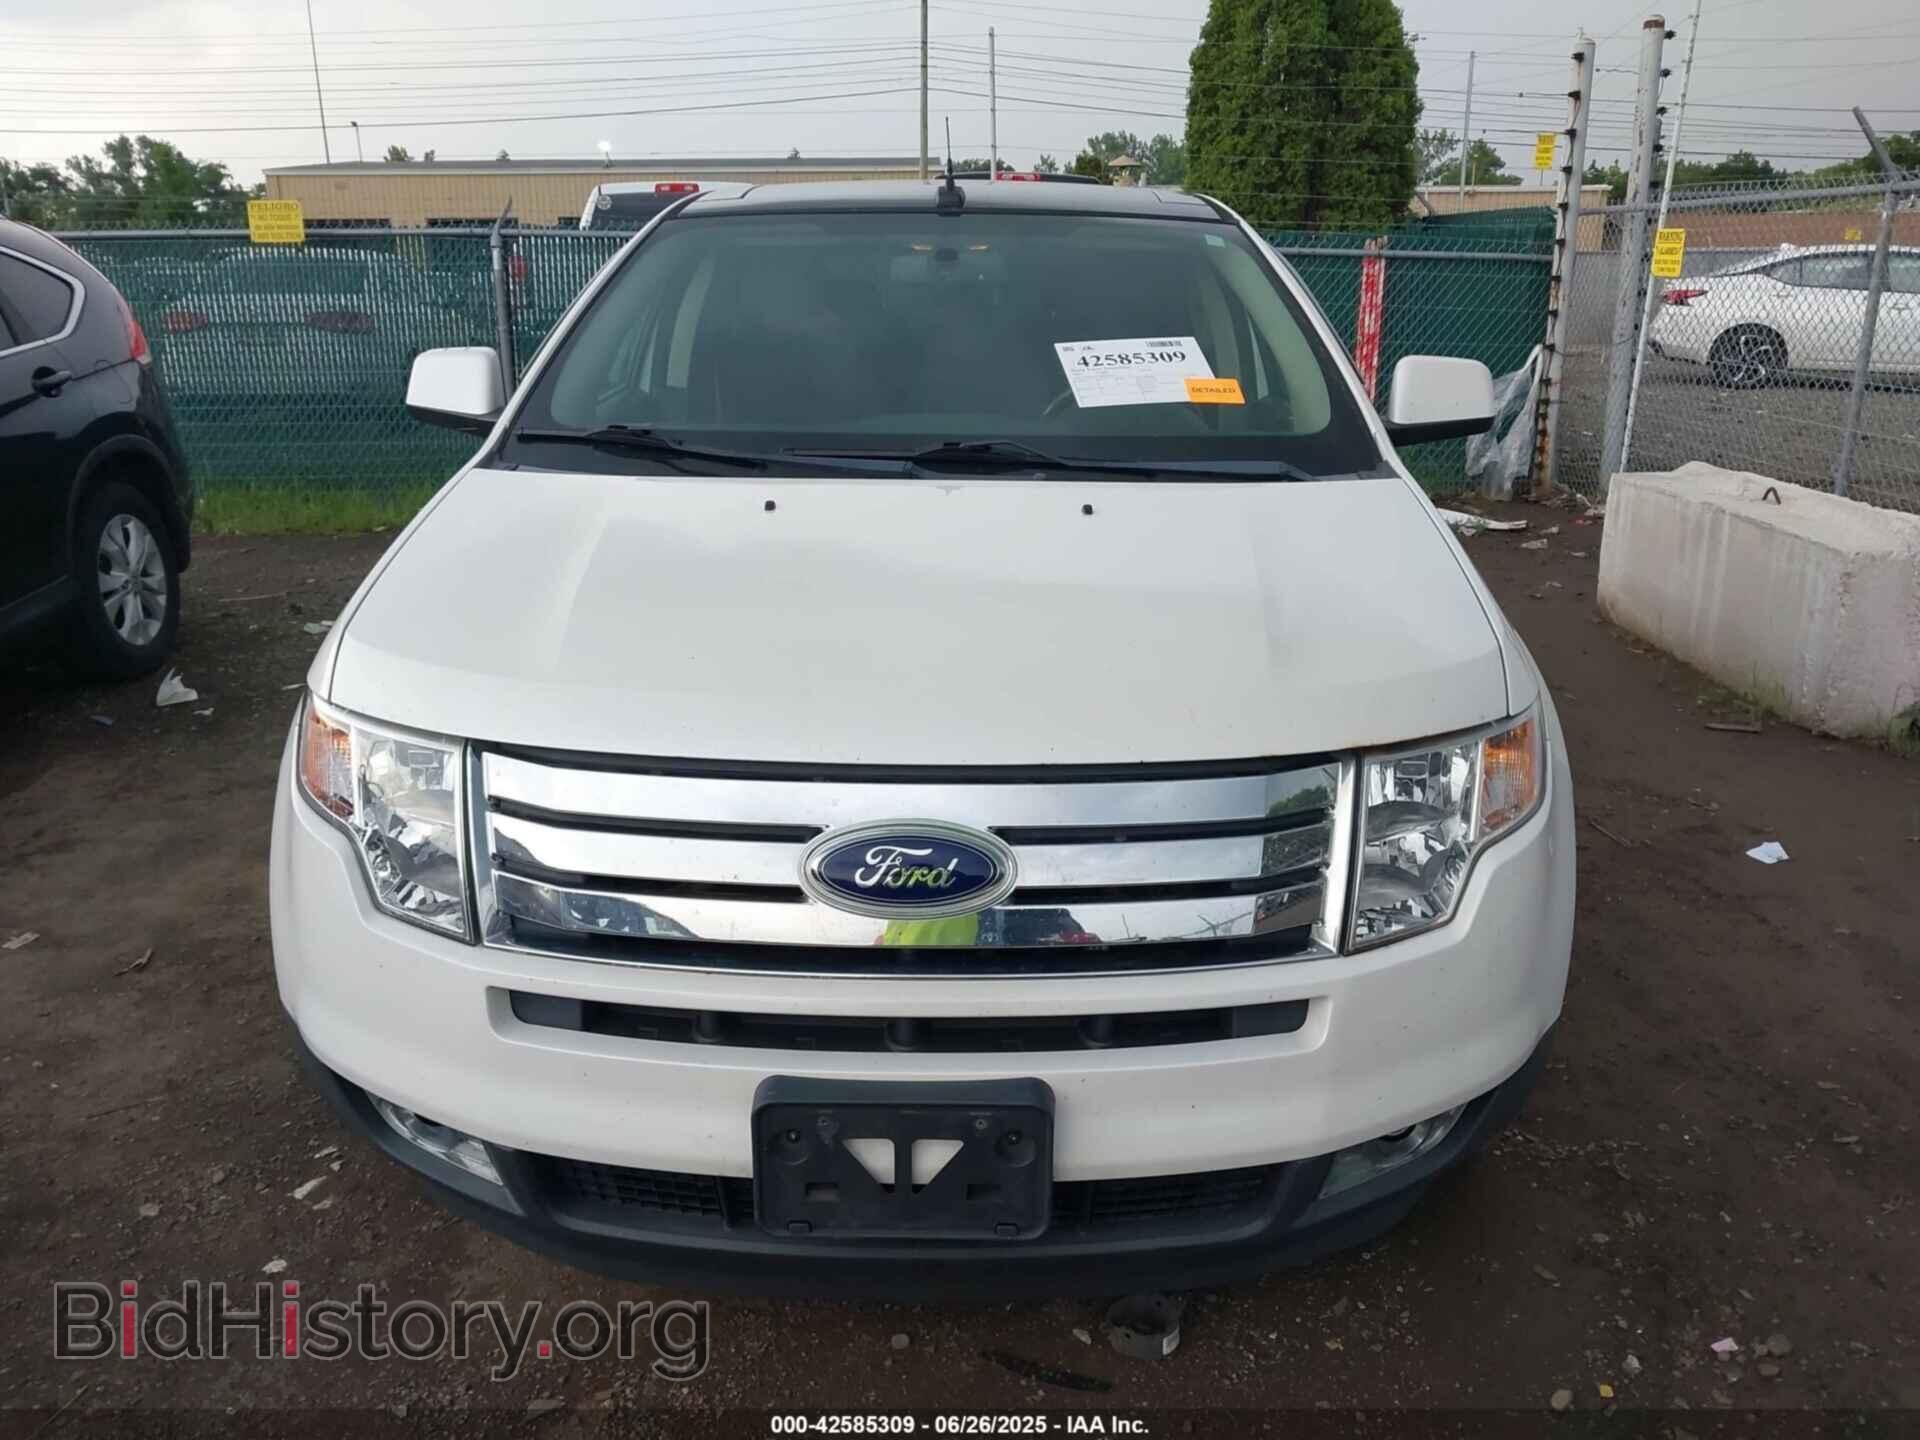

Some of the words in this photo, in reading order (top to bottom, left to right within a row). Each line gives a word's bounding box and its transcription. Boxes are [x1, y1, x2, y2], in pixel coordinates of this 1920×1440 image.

[250, 202, 297, 211] PELIGRO
[1077, 351, 1186, 368] 42585309
[1191, 386, 1236, 394] DETAILED
[854, 845, 959, 888] Ford
